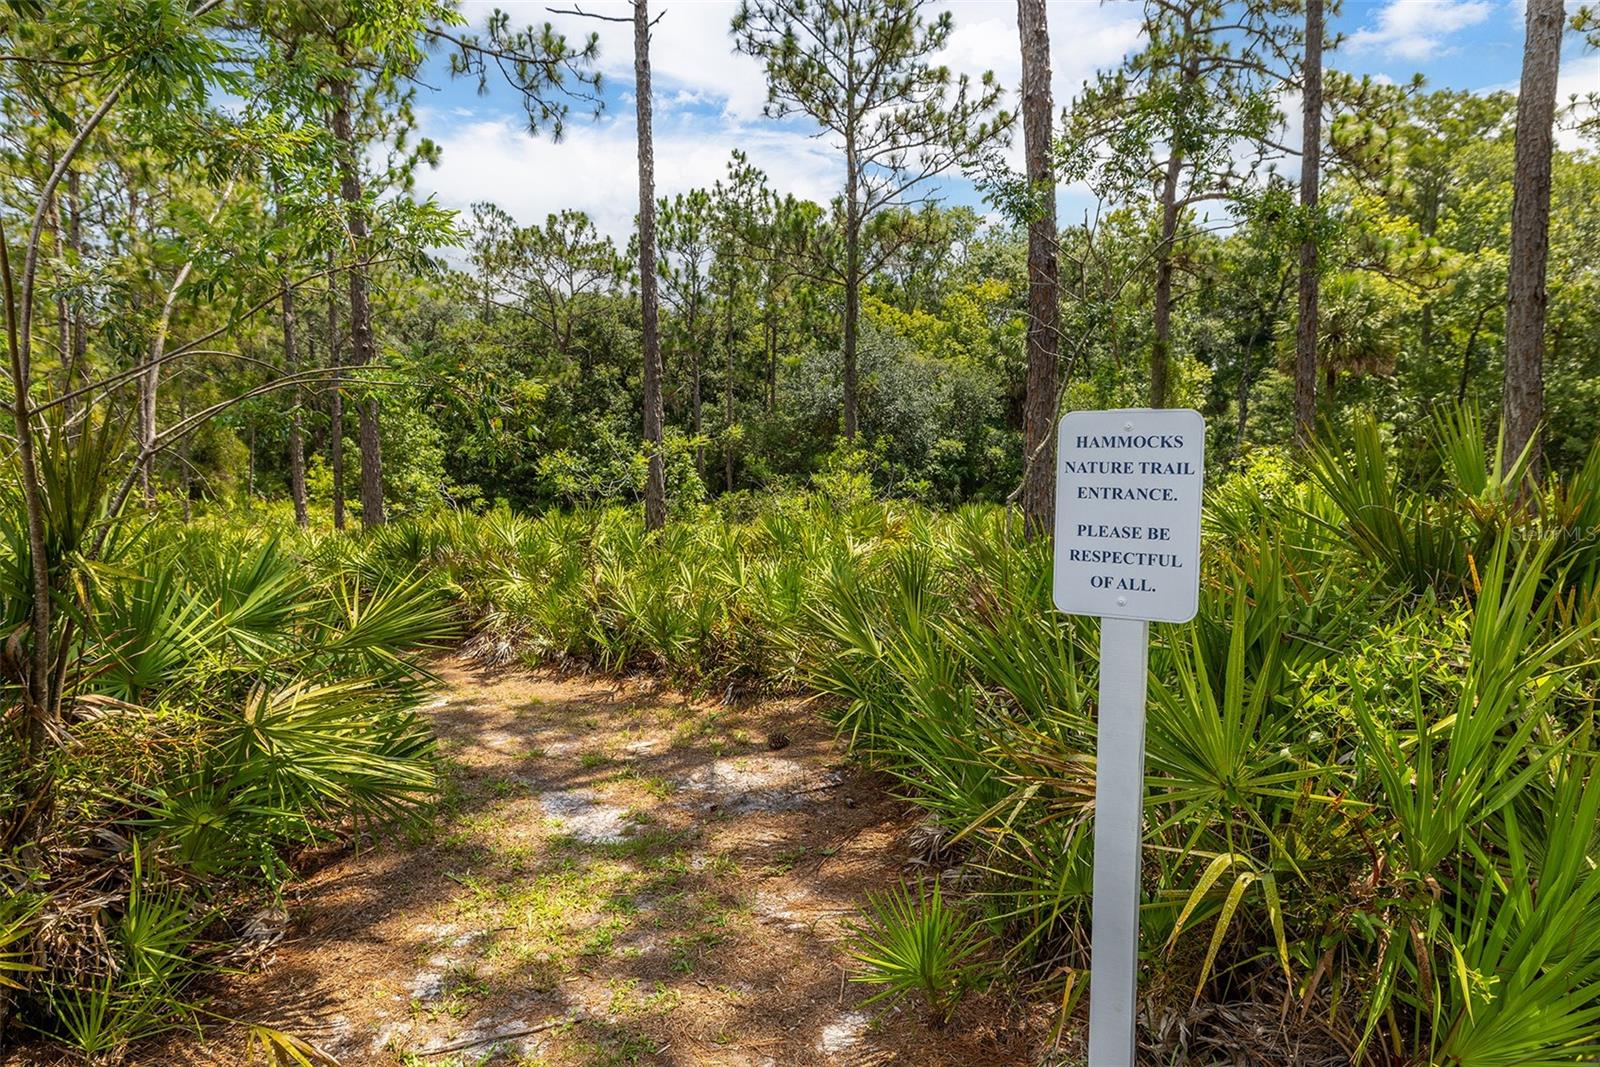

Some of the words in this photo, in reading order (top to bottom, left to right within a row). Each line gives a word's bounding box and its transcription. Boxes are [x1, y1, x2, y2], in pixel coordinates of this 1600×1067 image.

[1076, 436, 1185, 449] HAMMOCKS
[1064, 461, 1135, 475] NATURE
[1138, 461, 1195, 476] TRAIL
[1077, 486, 1178, 502] ENTRANCE.
[1077, 524, 1143, 540] PLEASE
[1147, 527, 1171, 541] BE
[1069, 549, 1183, 568] RESPECTFUL
[1090, 575, 1115, 589] OF
[1116, 577, 1156, 593] ALL.
